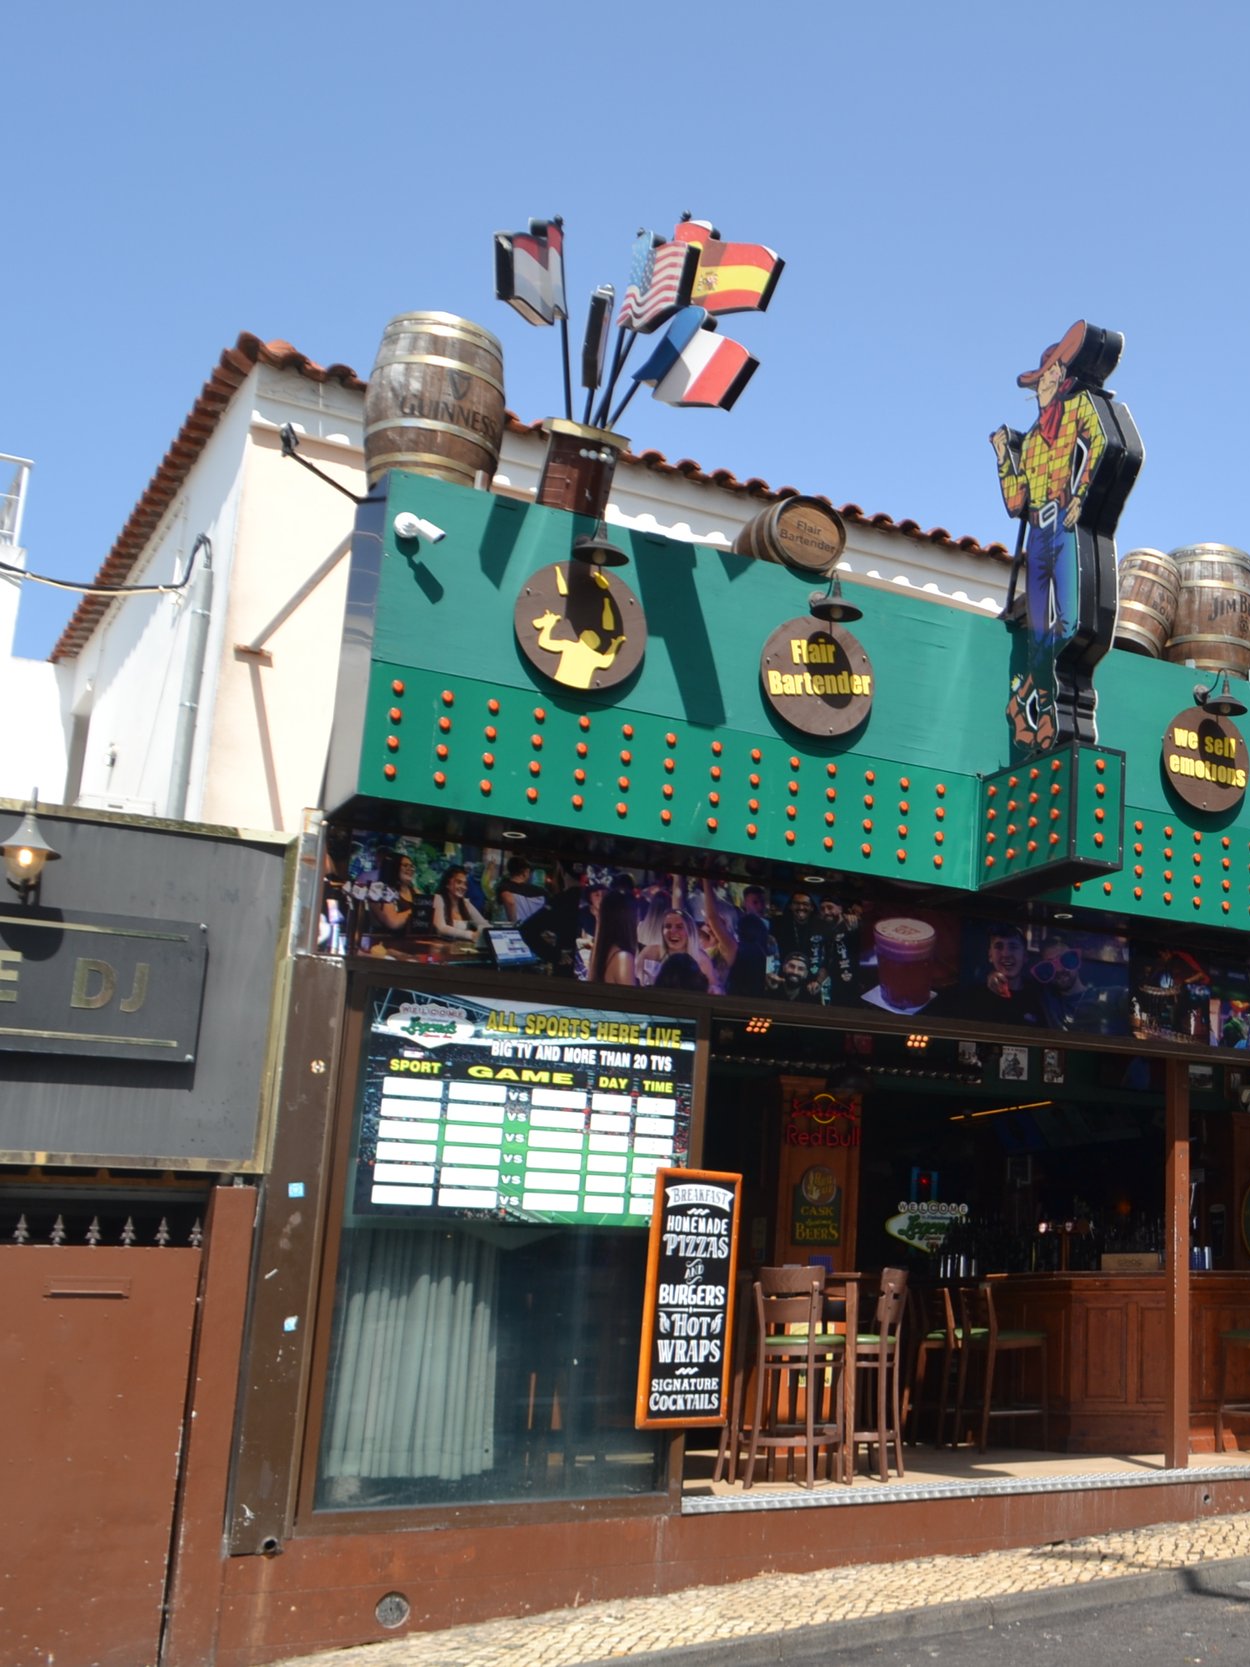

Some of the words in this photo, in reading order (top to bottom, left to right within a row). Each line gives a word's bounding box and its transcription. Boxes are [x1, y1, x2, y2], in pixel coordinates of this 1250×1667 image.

[400, 395, 498, 441] GUINNESS
[796, 519, 823, 536] Flair
[779, 528, 837, 554] Bartender
[790, 638, 837, 664] Flair
[768, 670, 871, 697] Bartender
[1173, 727, 1199, 750] we
[1204, 734, 1237, 760] sell
[1169, 753, 1246, 789] emotions
[70, 957, 150, 1013] DJ
[402, 1005, 466, 1019] WELCOME
[485, 1011, 519, 1035] ALL
[526, 1015, 592, 1042] SPORTS
[596, 1022, 641, 1045] HERE
[646, 1026, 683, 1049] LIVE
[491, 1040, 512, 1058] BIG
[514, 1042, 534, 1060] TV
[535, 1044, 561, 1063] AND
[563, 1046, 596, 1065] MORE
[600, 1050, 632, 1067] THAN
[633, 1053, 649, 1070] 20
[650, 1055, 673, 1073] TVS
[389, 1058, 442, 1075] SPORT
[467, 1065, 574, 1087] GAME
[598, 1076, 629, 1091] DAY
[642, 1079, 674, 1095] TIME
[786, 1123, 824, 1147] Red
[825, 1126, 862, 1148] Bull
[671, 1186, 729, 1207] BREAKFAST
[898, 1202, 968, 1215] WELCOME
[800, 1205, 835, 1218] CASK
[666, 1215, 729, 1234] HOMEMADE
[795, 1221, 839, 1242] BEERS
[662, 1233, 729, 1260] PIZZAS
[684, 1263, 704, 1280] AND
[658, 1283, 726, 1307] BURGERS
[671, 1312, 711, 1337] HOT
[657, 1339, 721, 1364] WRAPS
[651, 1377, 719, 1392] SIGNATURE
[649, 1392, 719, 1411] COCKTAILS
